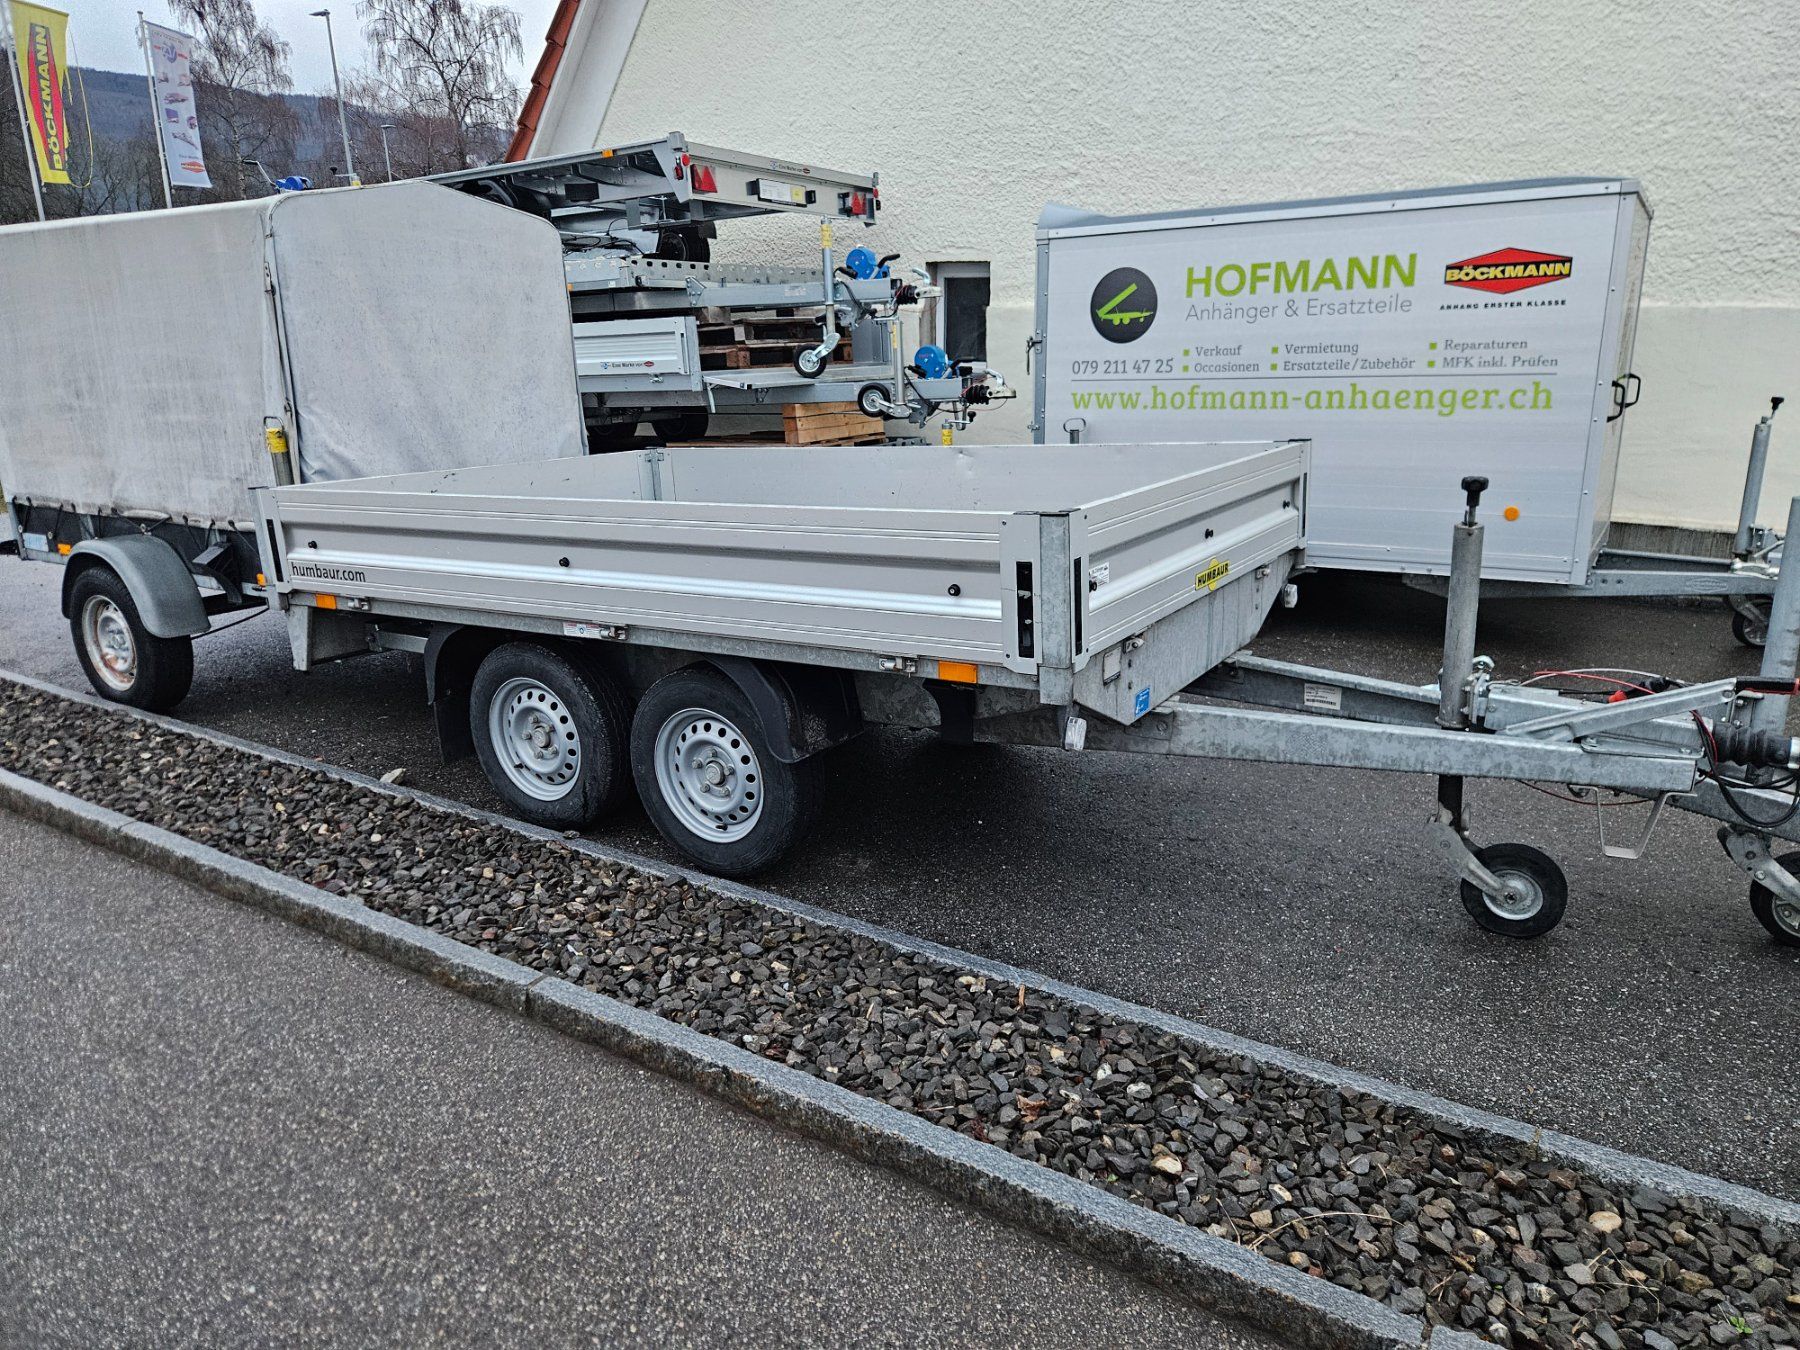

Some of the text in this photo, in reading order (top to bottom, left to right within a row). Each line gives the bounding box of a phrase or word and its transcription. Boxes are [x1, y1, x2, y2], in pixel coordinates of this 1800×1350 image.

[34, 25, 62, 169] BÖCKMANN
[1186, 253, 1417, 298] HOFMANN
[1445, 262, 1571, 281] BÖCKMANN
[1186, 293, 1413, 324] Anhänger & Ersatzteile
[1195, 345, 1243, 357] Verkauf
[1285, 343, 1359, 356] Vermietung
[1444, 339, 1528, 352] Reparaturen
[1072, 358, 1174, 375] 079 211 47 25
[1194, 361, 1260, 373] Occasionen
[1442, 354, 1558, 368] MFK inkl. Prüfen
[1071, 380, 1552, 417] www.hofmann-anhaenger.ch
[291, 561, 366, 582] humbaur.com
[1197, 563, 1229, 587] HUMBAUR
